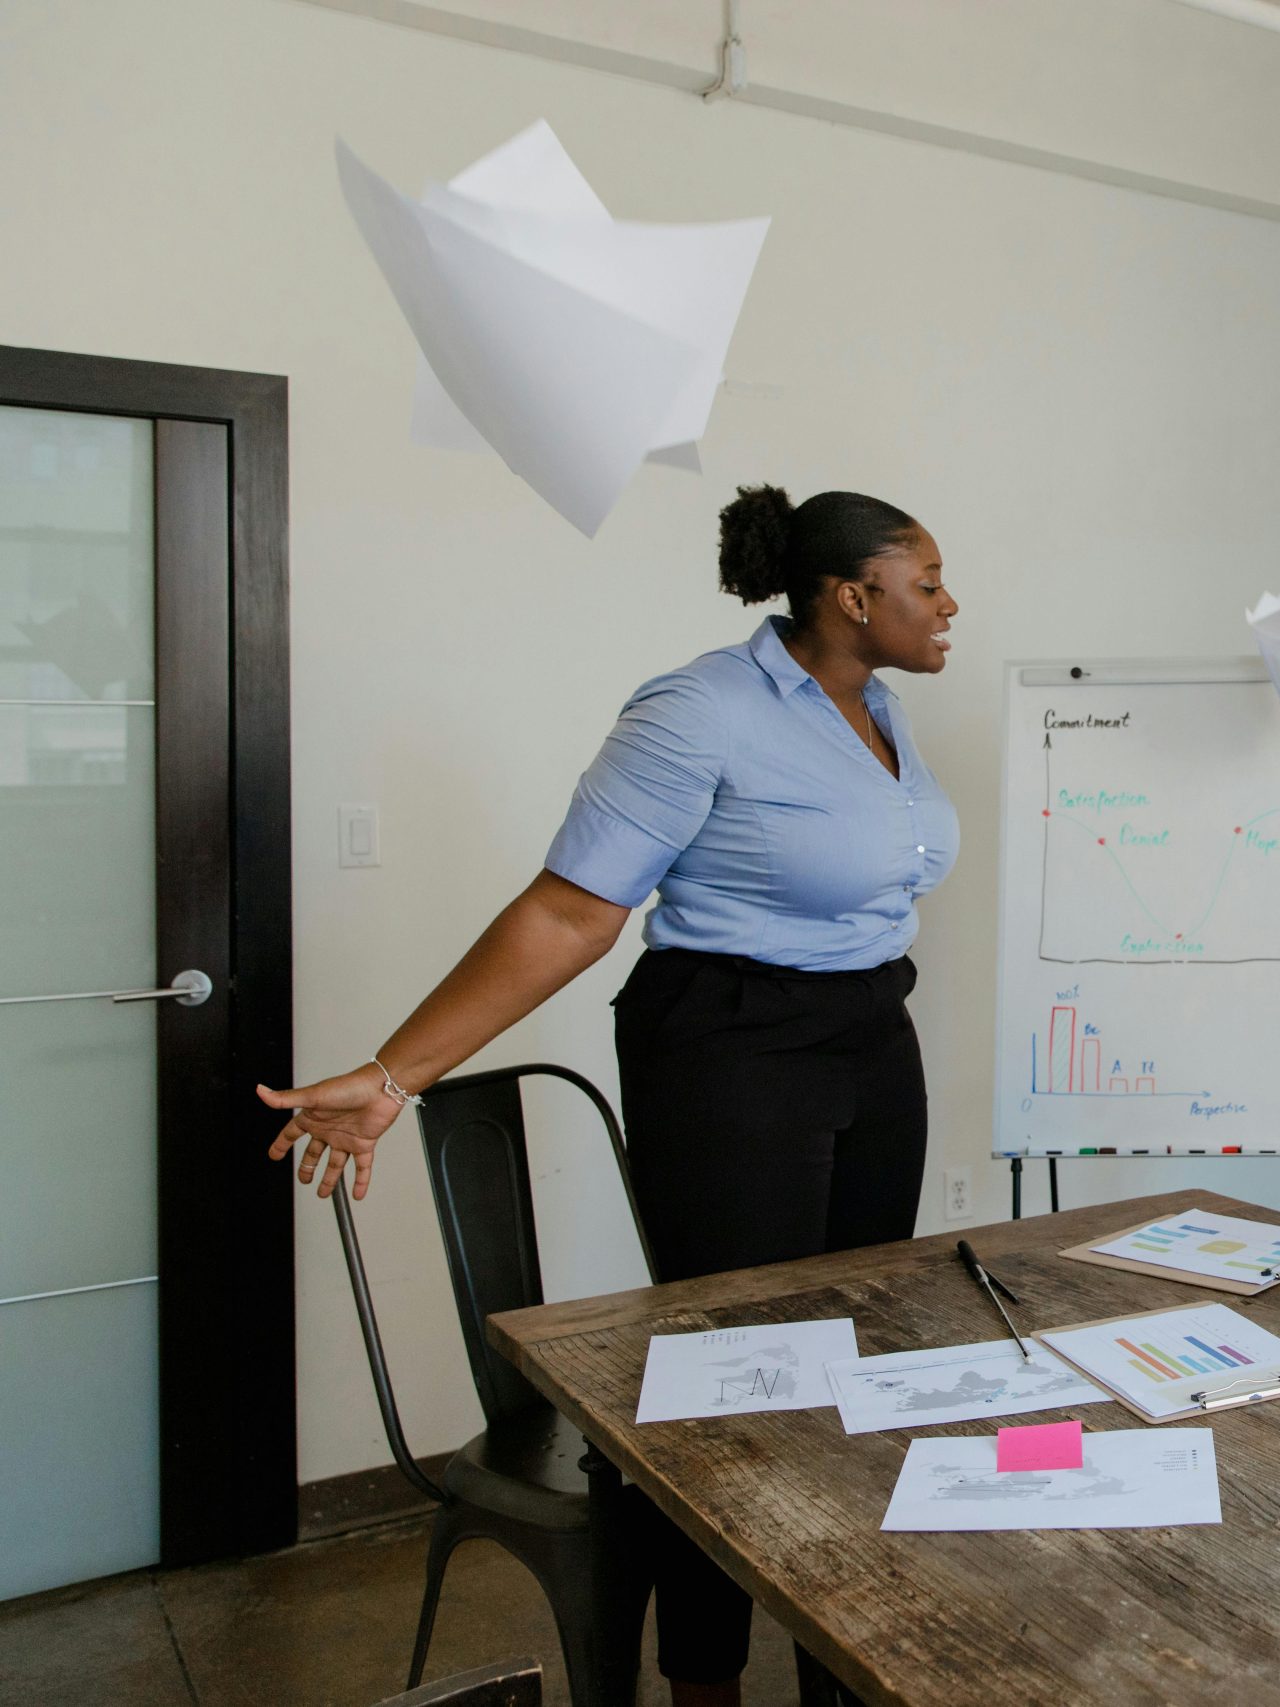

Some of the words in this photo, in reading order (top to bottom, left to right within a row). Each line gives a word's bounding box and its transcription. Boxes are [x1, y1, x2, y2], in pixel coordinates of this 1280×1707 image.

[1043, 709, 1131, 729] Commitment
[1246, 829, 1280, 855] Hope
[1111, 1058, 1123, 1074] A
